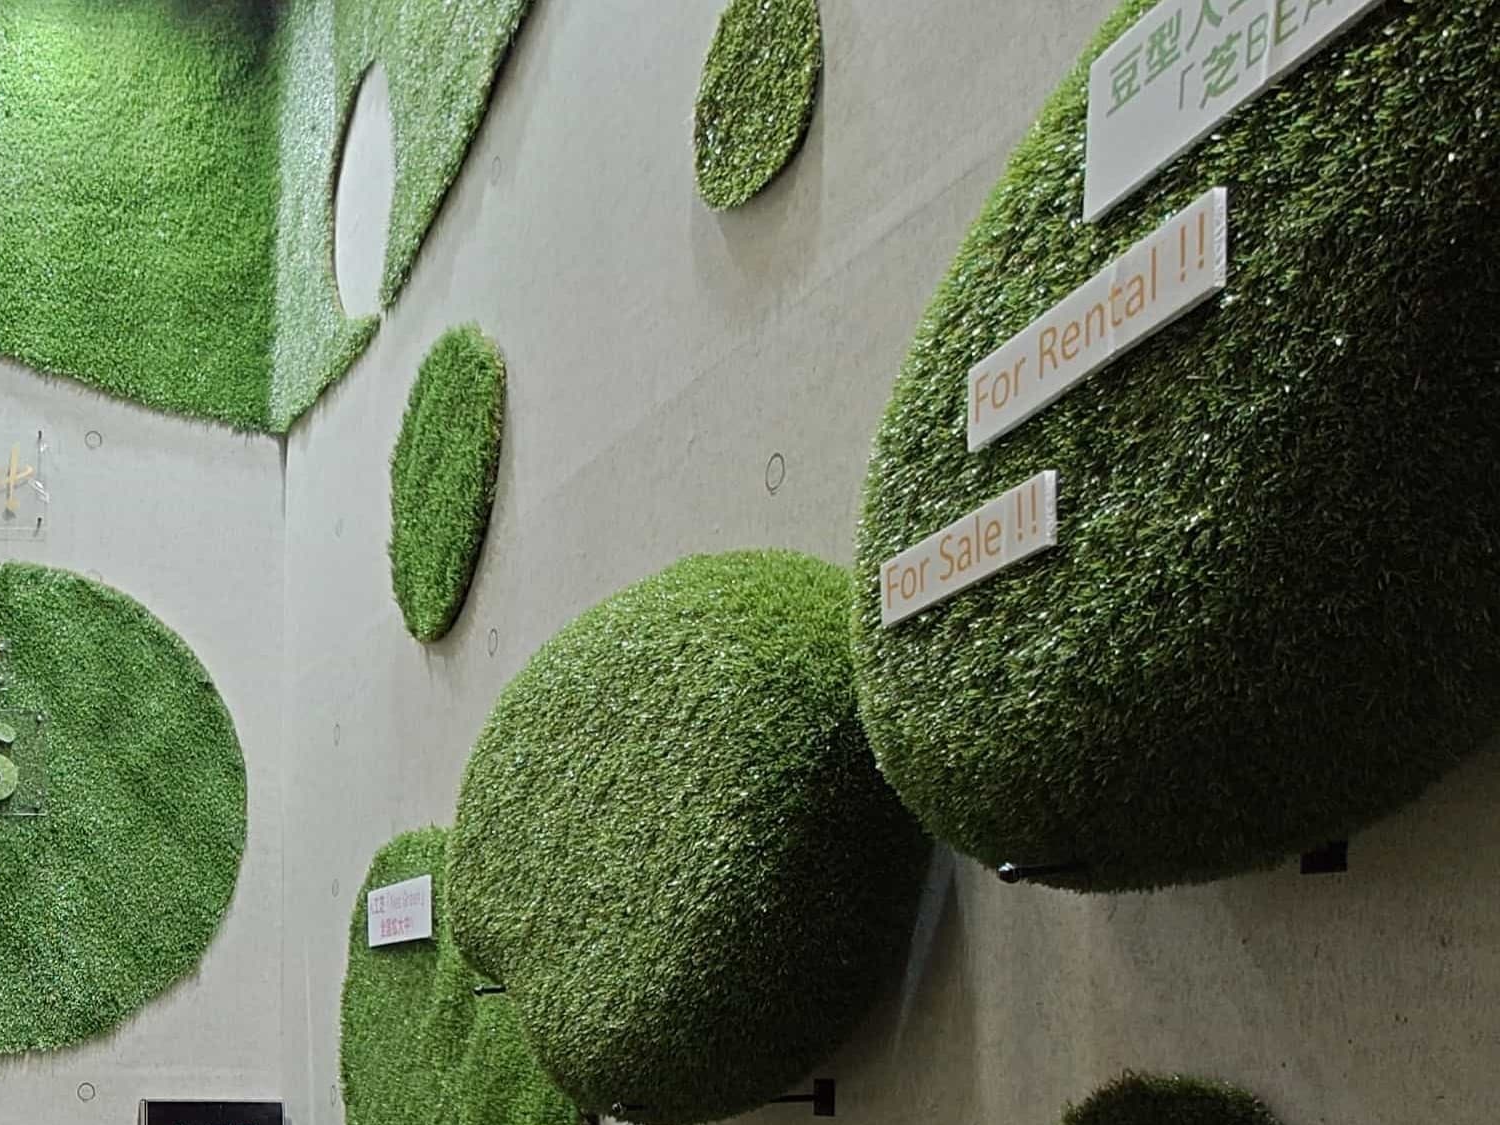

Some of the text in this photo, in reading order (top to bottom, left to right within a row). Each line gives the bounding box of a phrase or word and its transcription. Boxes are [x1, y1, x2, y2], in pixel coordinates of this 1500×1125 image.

[975, 357, 1027, 424] For
[1037, 247, 1156, 379] Rental
[886, 558, 931, 610] For
[939, 515, 1001, 581] Sale
